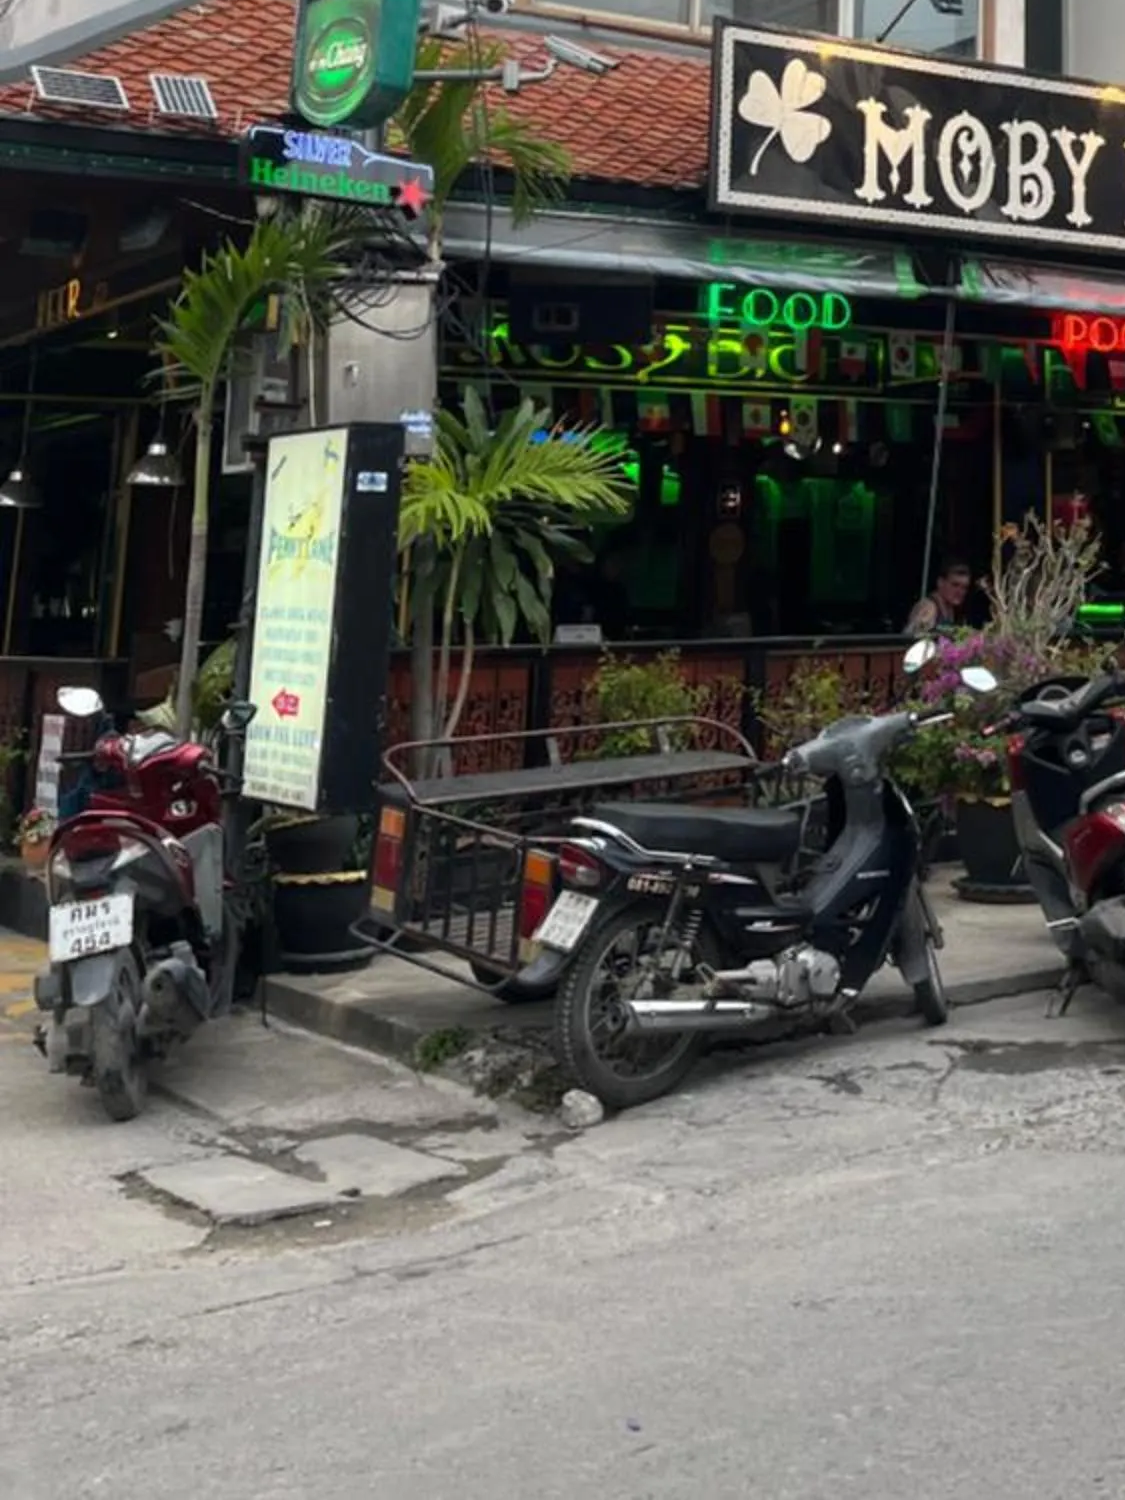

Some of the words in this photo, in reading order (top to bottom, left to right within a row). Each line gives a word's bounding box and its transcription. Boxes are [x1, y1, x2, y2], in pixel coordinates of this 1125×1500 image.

[250, 158, 392, 204] Heineken
[855, 96, 1106, 229] MOBY
[707, 282, 852, 330] FOOD
